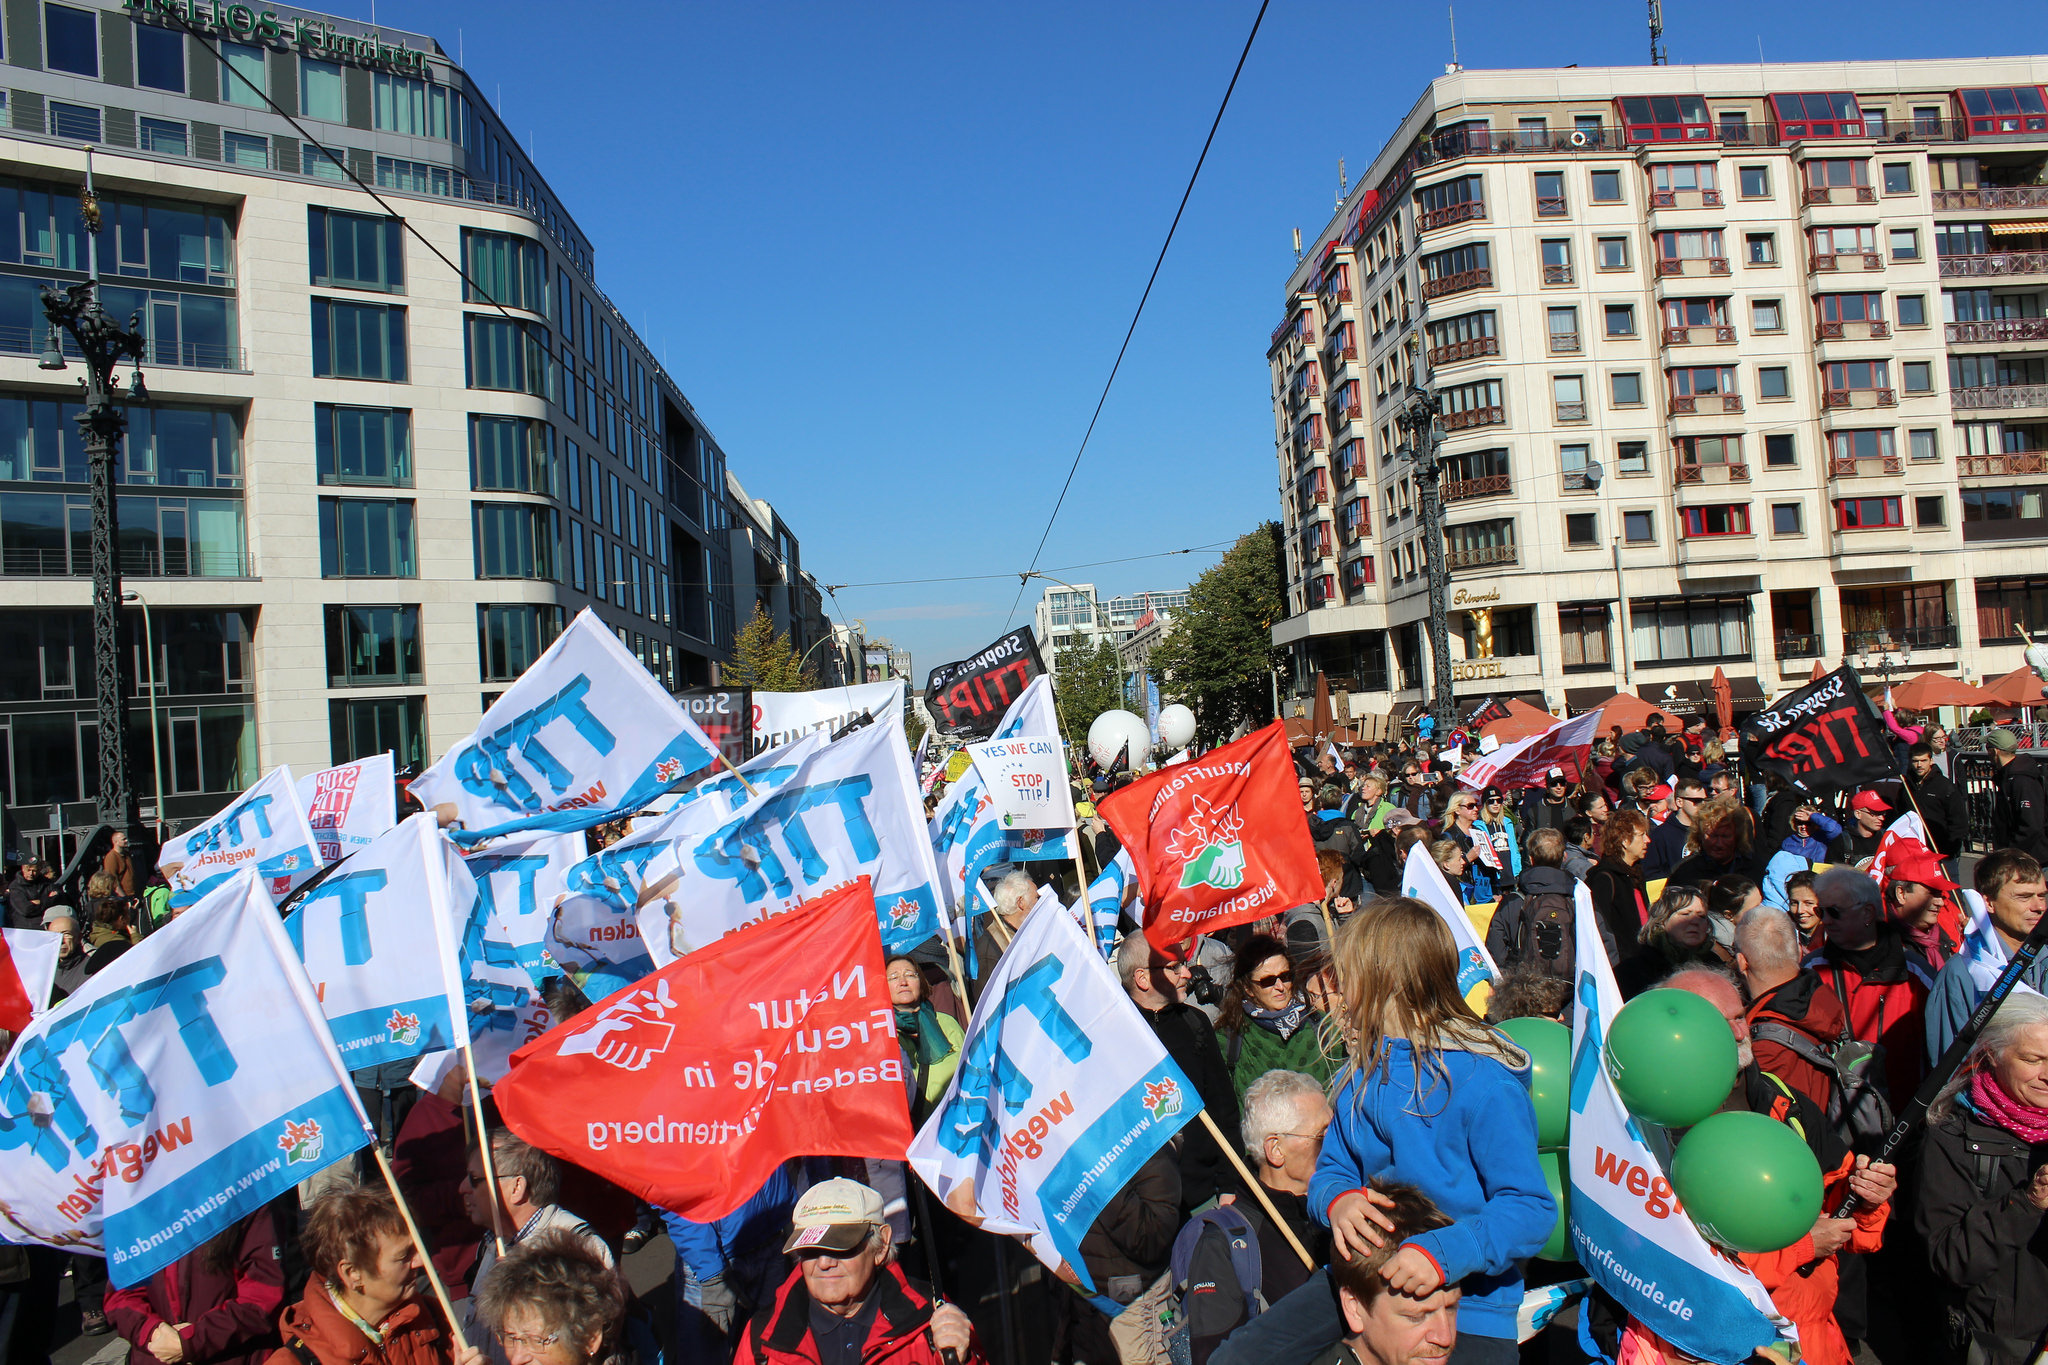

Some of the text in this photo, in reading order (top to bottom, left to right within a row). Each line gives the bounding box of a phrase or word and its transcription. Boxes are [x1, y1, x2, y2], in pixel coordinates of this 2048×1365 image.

[290, 16, 428, 71] Kliniken
[1452, 662, 1507, 680] HOTEL
[981, 746, 1006, 758] YES
[1006, 743, 1028, 755] WE
[1029, 742, 1053, 754] CAN
[1011, 774, 1043, 787] STOP
[1883, 1120, 1909, 1155] 400
